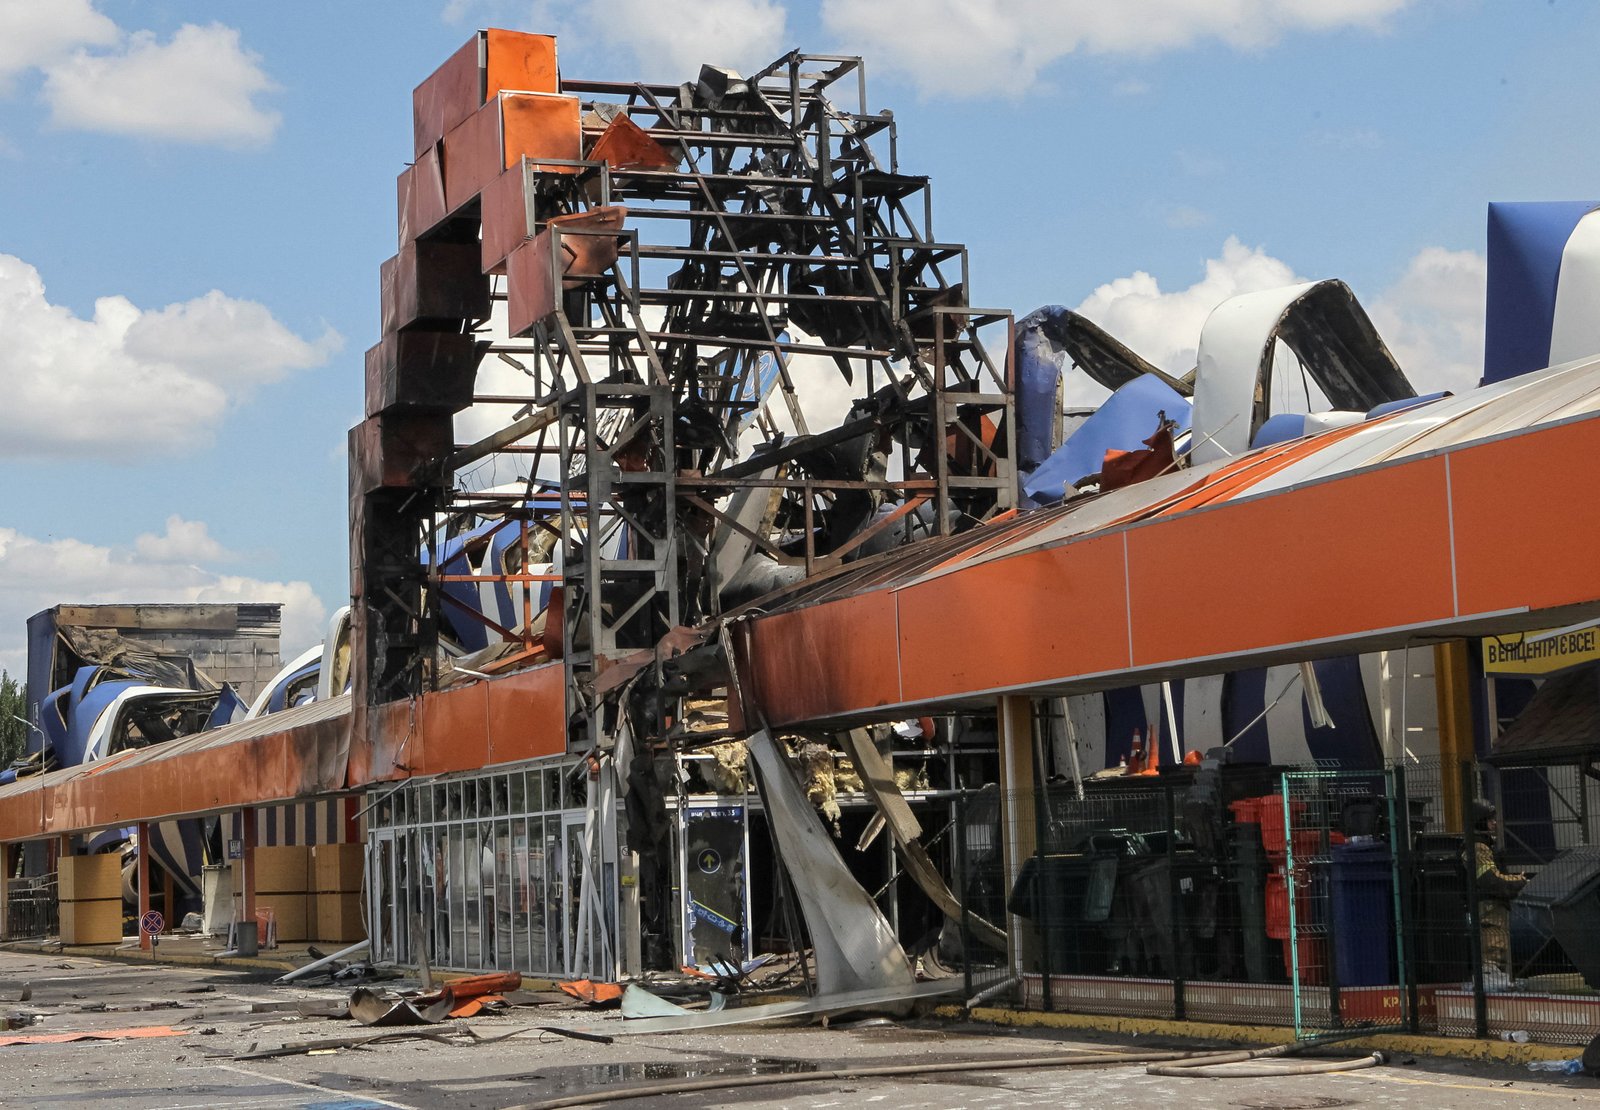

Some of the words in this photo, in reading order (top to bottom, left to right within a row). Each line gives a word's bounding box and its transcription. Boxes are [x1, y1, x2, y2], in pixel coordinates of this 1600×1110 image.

[1489, 645, 1497, 663] В
[1560, 636, 1567, 654] Є
[1568, 631, 1595, 653] ВСЕ!
